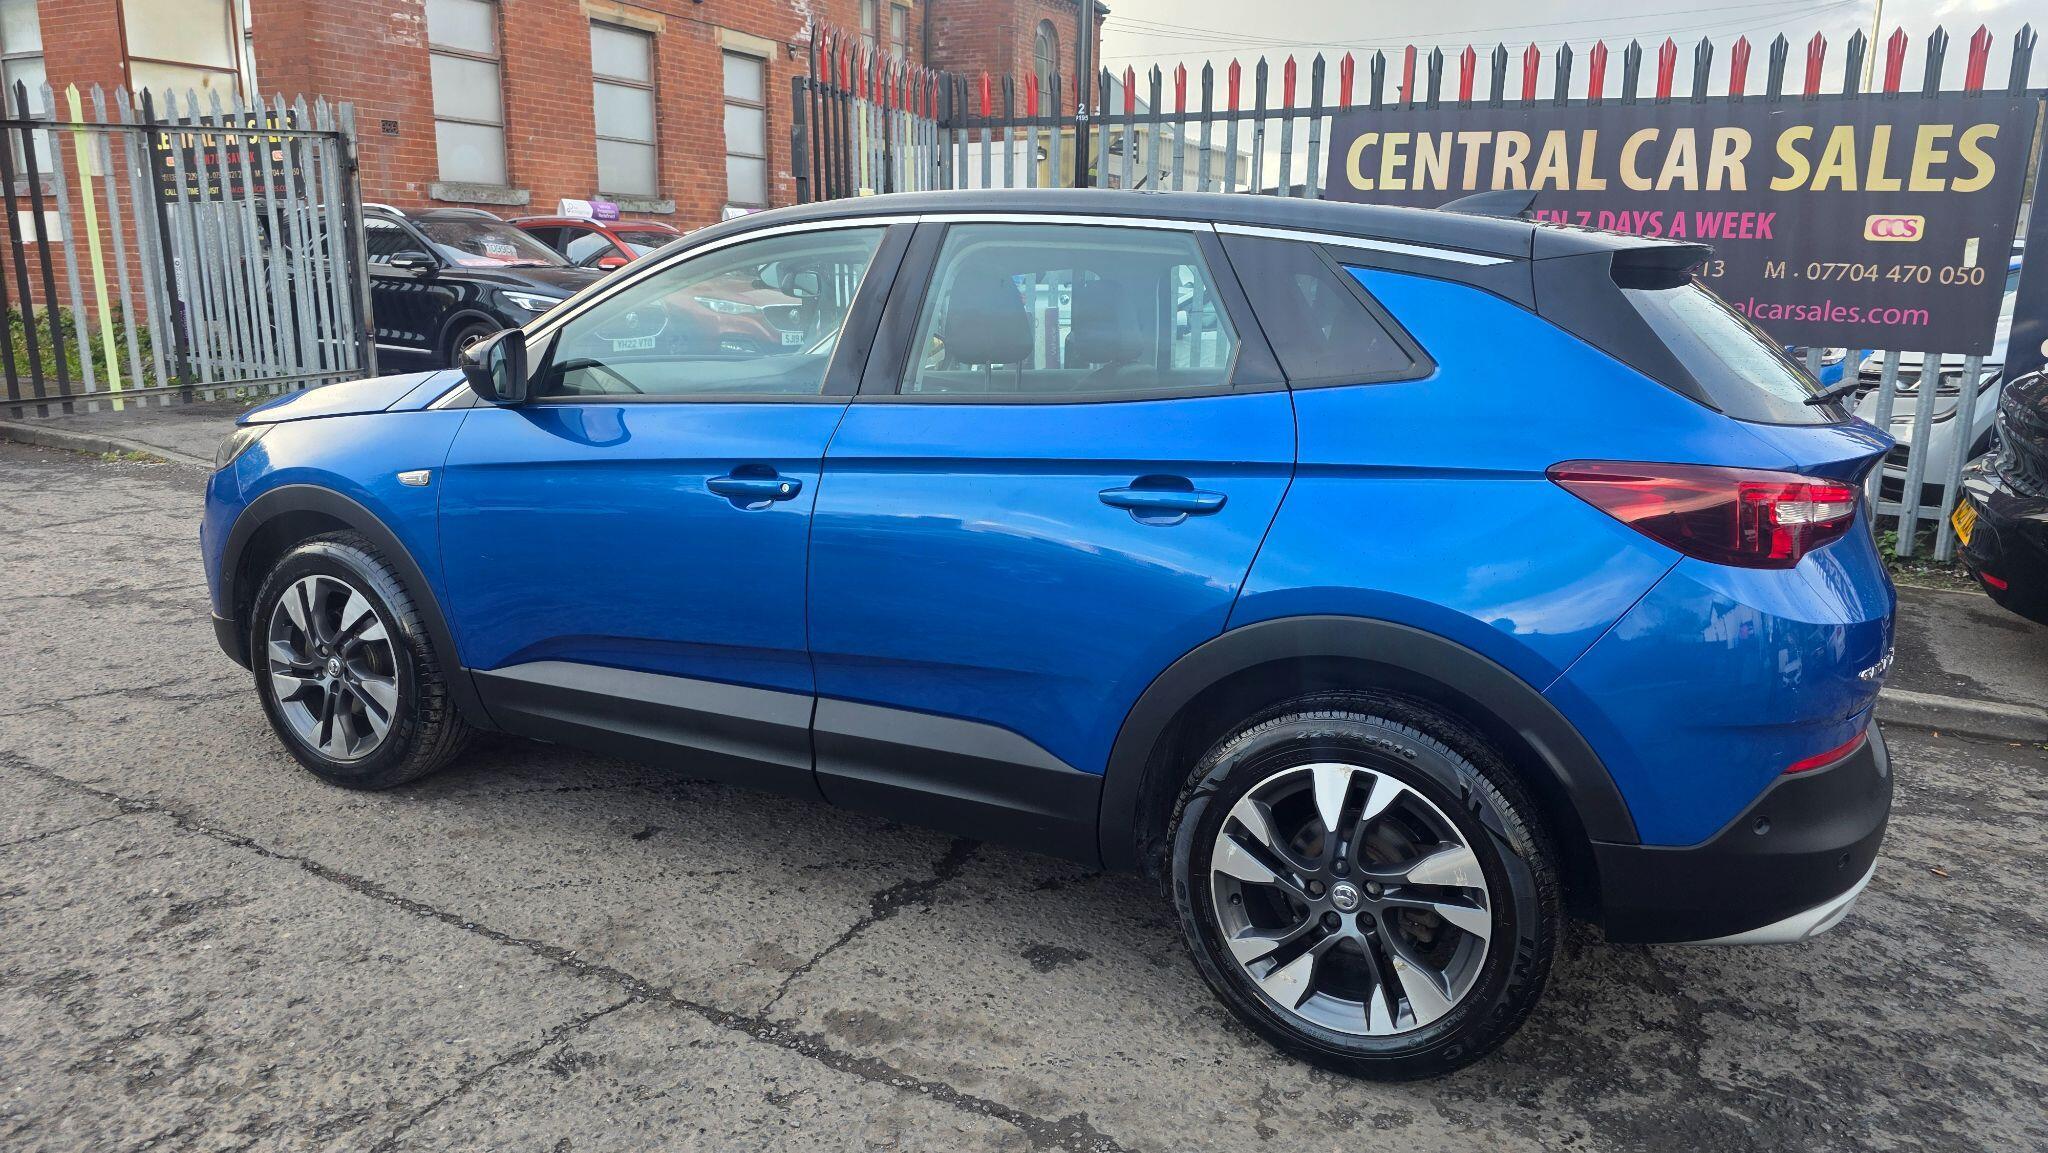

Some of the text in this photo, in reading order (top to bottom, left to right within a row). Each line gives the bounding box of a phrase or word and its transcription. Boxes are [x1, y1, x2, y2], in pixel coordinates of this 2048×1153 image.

[1078, 103, 1085, 114] 2
[1345, 123, 2001, 192] CENTRAL CAR SALES
[1598, 210, 1663, 237] DAYS
[1667, 210, 1686, 238] A
[1695, 210, 1777, 240] WEEK
[1871, 218, 1918, 238] CCS
[1806, 261, 1879, 282] 07704
[1885, 263, 1932, 284] 470
[1939, 265, 1985, 286] 050
[1731, 296, 1930, 326] alcarsales.com
